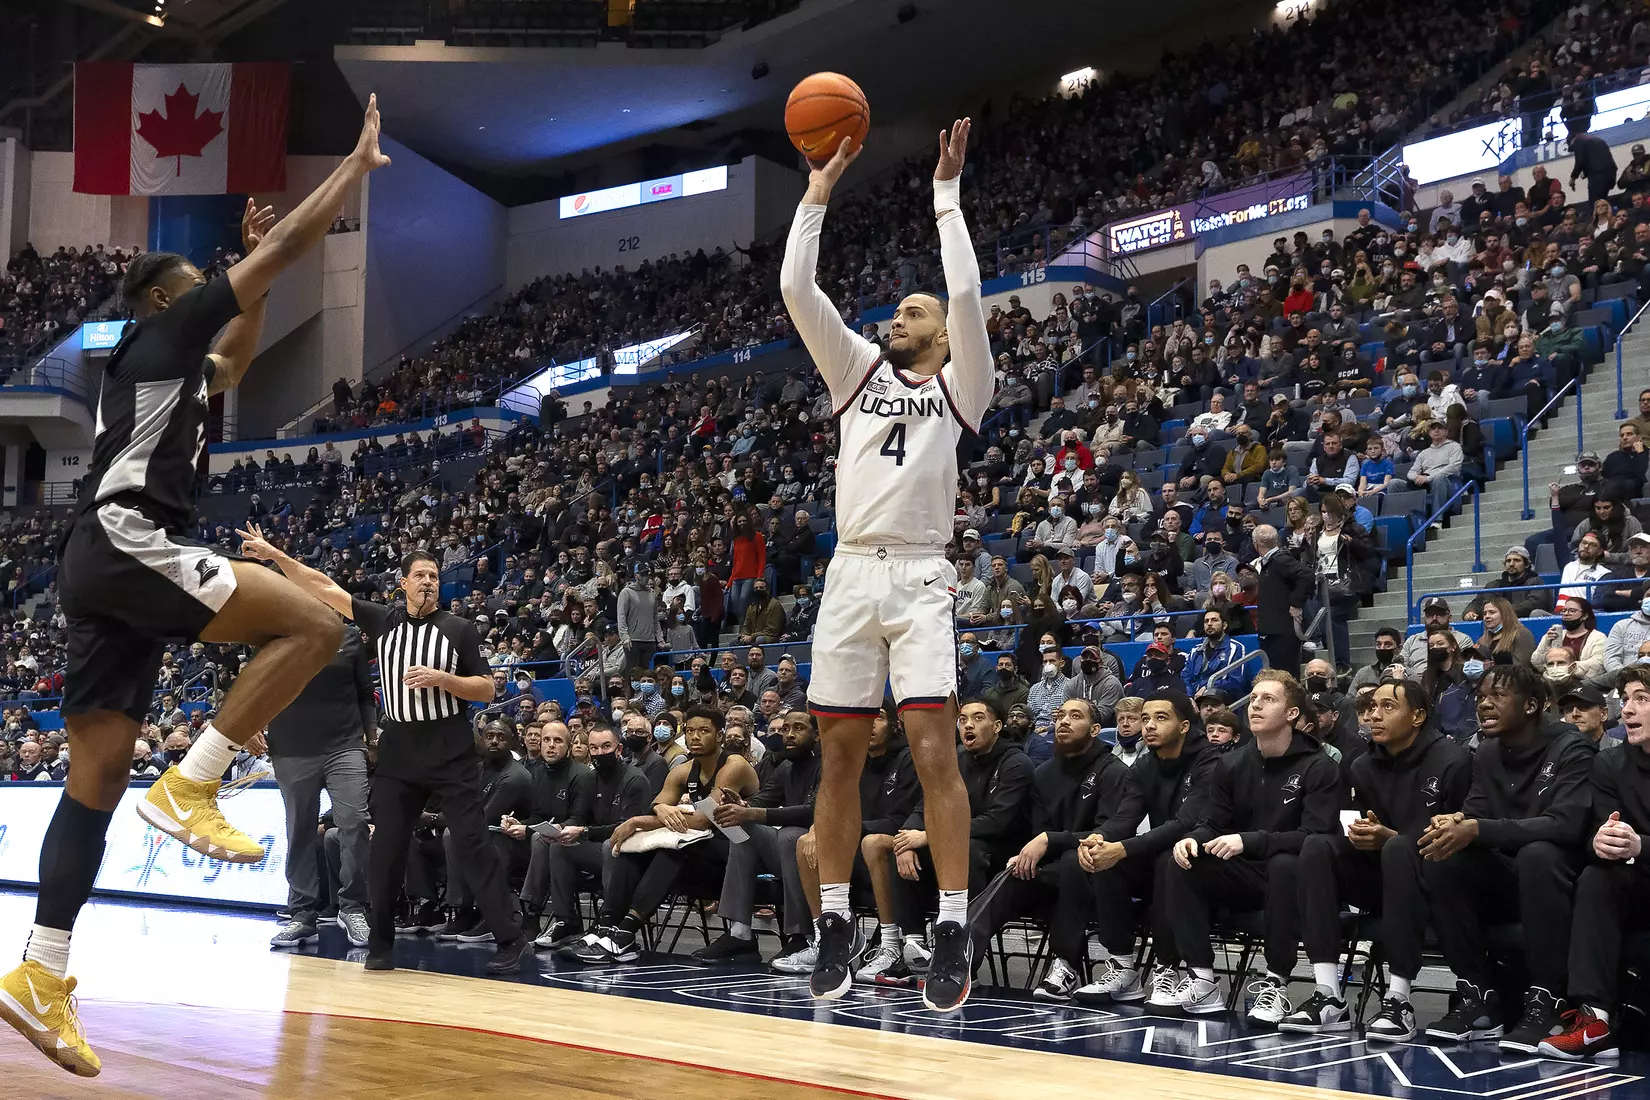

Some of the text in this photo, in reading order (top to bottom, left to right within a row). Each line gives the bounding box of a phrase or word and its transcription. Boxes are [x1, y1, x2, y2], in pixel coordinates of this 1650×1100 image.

[1285, 1, 1310, 20] 214
[1068, 75, 1089, 91] 213
[1534, 139, 1570, 162] 116
[1116, 219, 1171, 244] WATCH
[1159, 233, 1171, 243] CT
[618, 236, 640, 252] 212
[1020, 267, 1046, 286] 115
[89, 333, 115, 343] Hilton
[732, 350, 751, 364] 114
[860, 393, 944, 418] UCONN
[434, 414, 448, 426] 113
[880, 422, 906, 467] 4
[61, 456, 80, 466] 112
